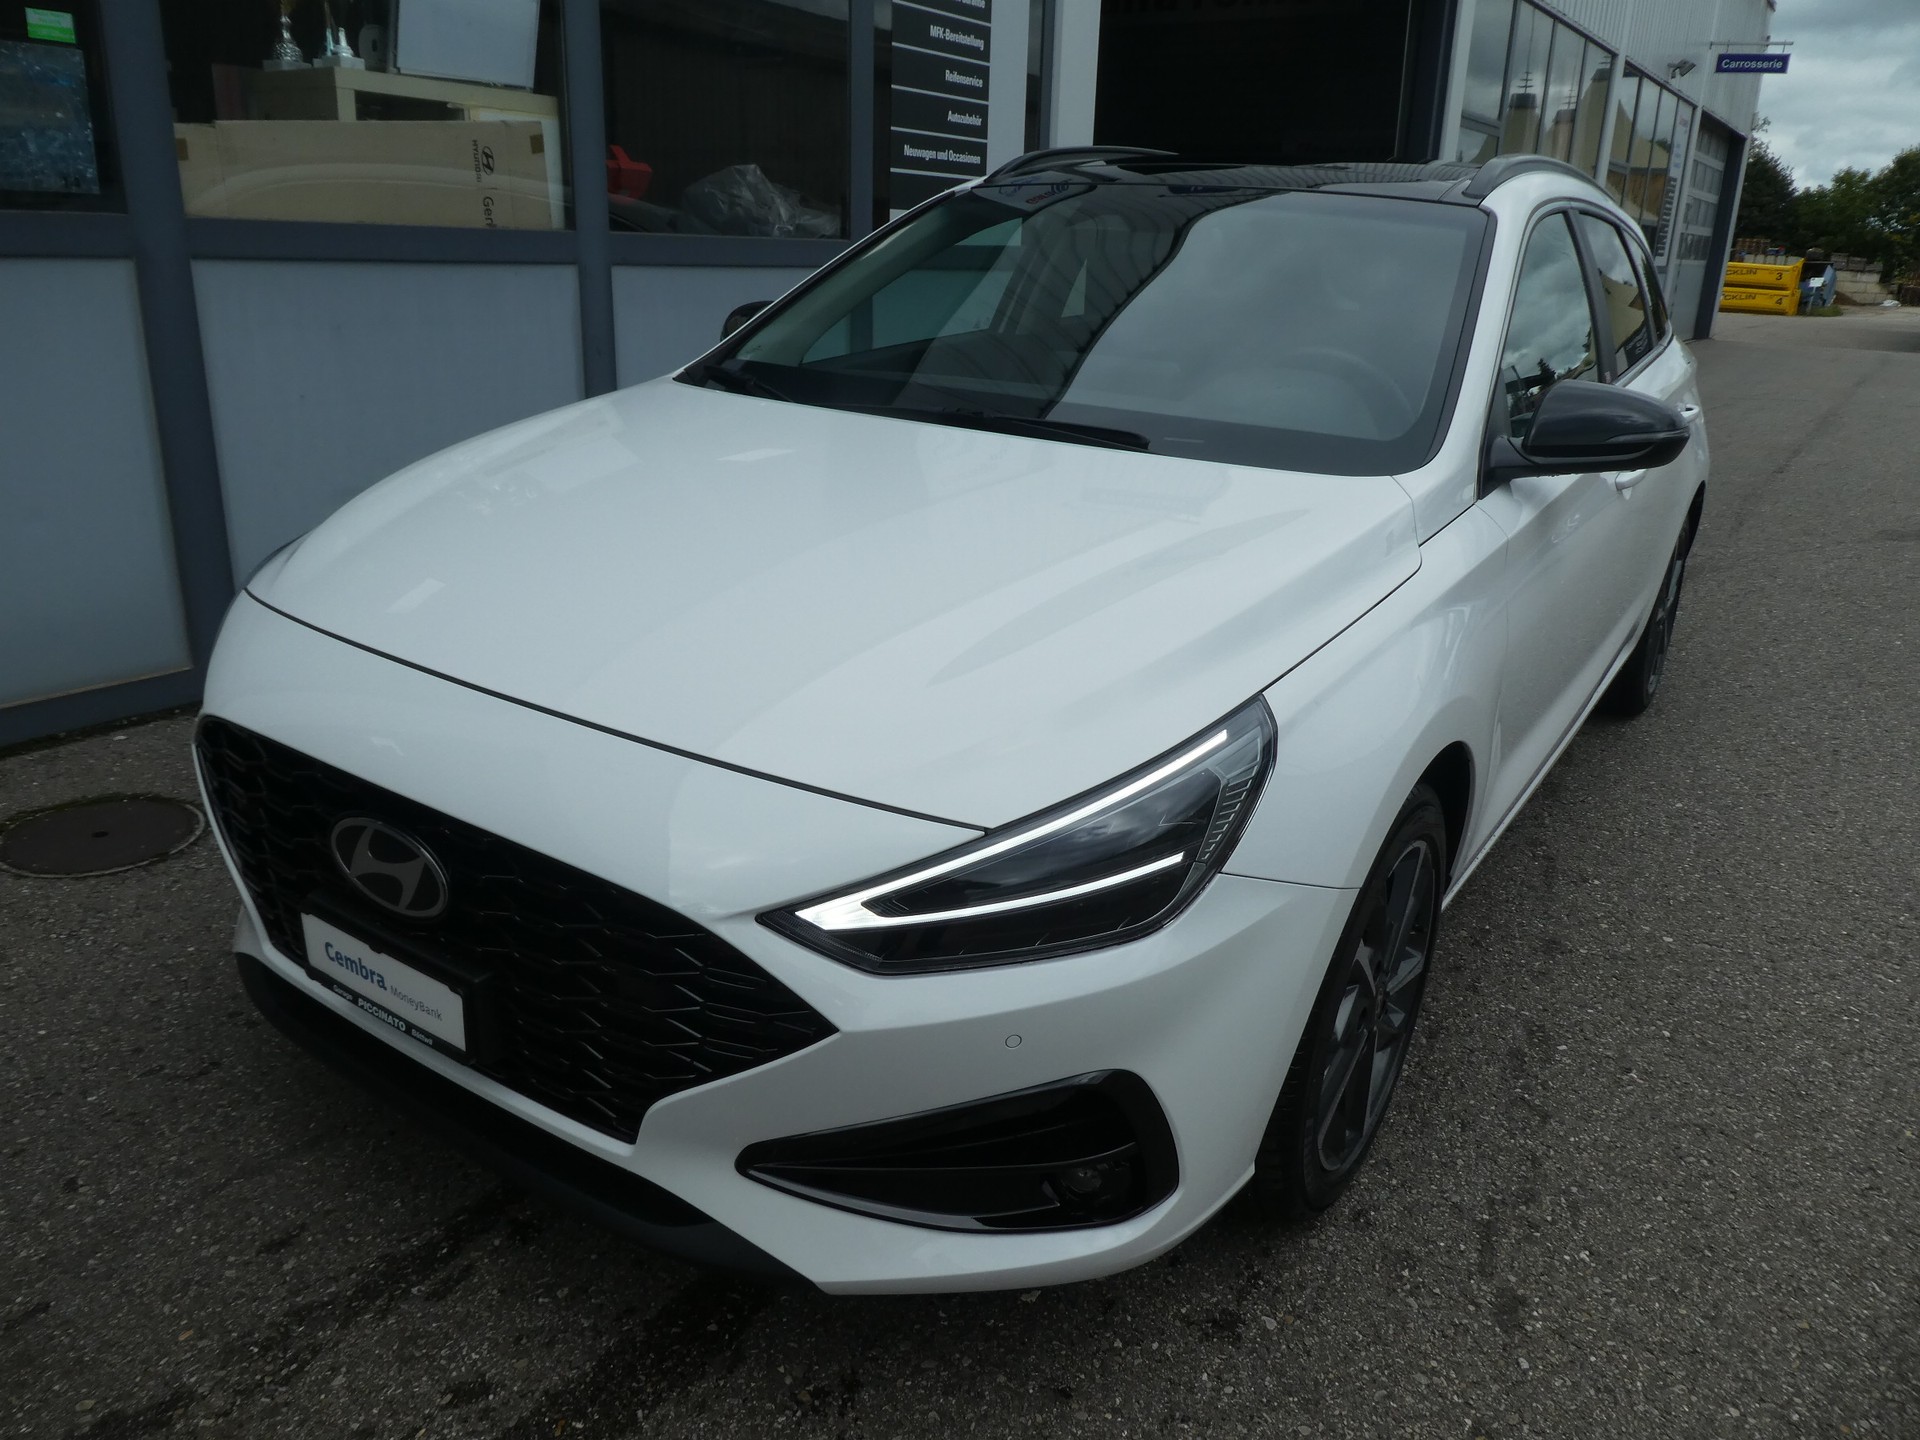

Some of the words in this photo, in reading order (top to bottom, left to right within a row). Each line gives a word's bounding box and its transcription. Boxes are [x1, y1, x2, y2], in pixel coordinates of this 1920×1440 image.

[929, 24, 984, 51] MFK-Bereitstellung
[1721, 59, 1783, 69] Carrosserie
[945, 69, 983, 88] Reifenservice
[947, 110, 982, 126] Autozubehör
[904, 144, 936, 161] Neuwagen
[937, 149, 948, 160] und
[949, 149, 981, 164] Occasionen
[483, 196, 497, 228] Gen
[1775, 272, 1783, 281] 3
[1775, 297, 1783, 306] 4
[324, 942, 388, 991] Cembra
[390, 985, 443, 1022] MoneyBank
[358, 998, 406, 1032] PICCINATO
